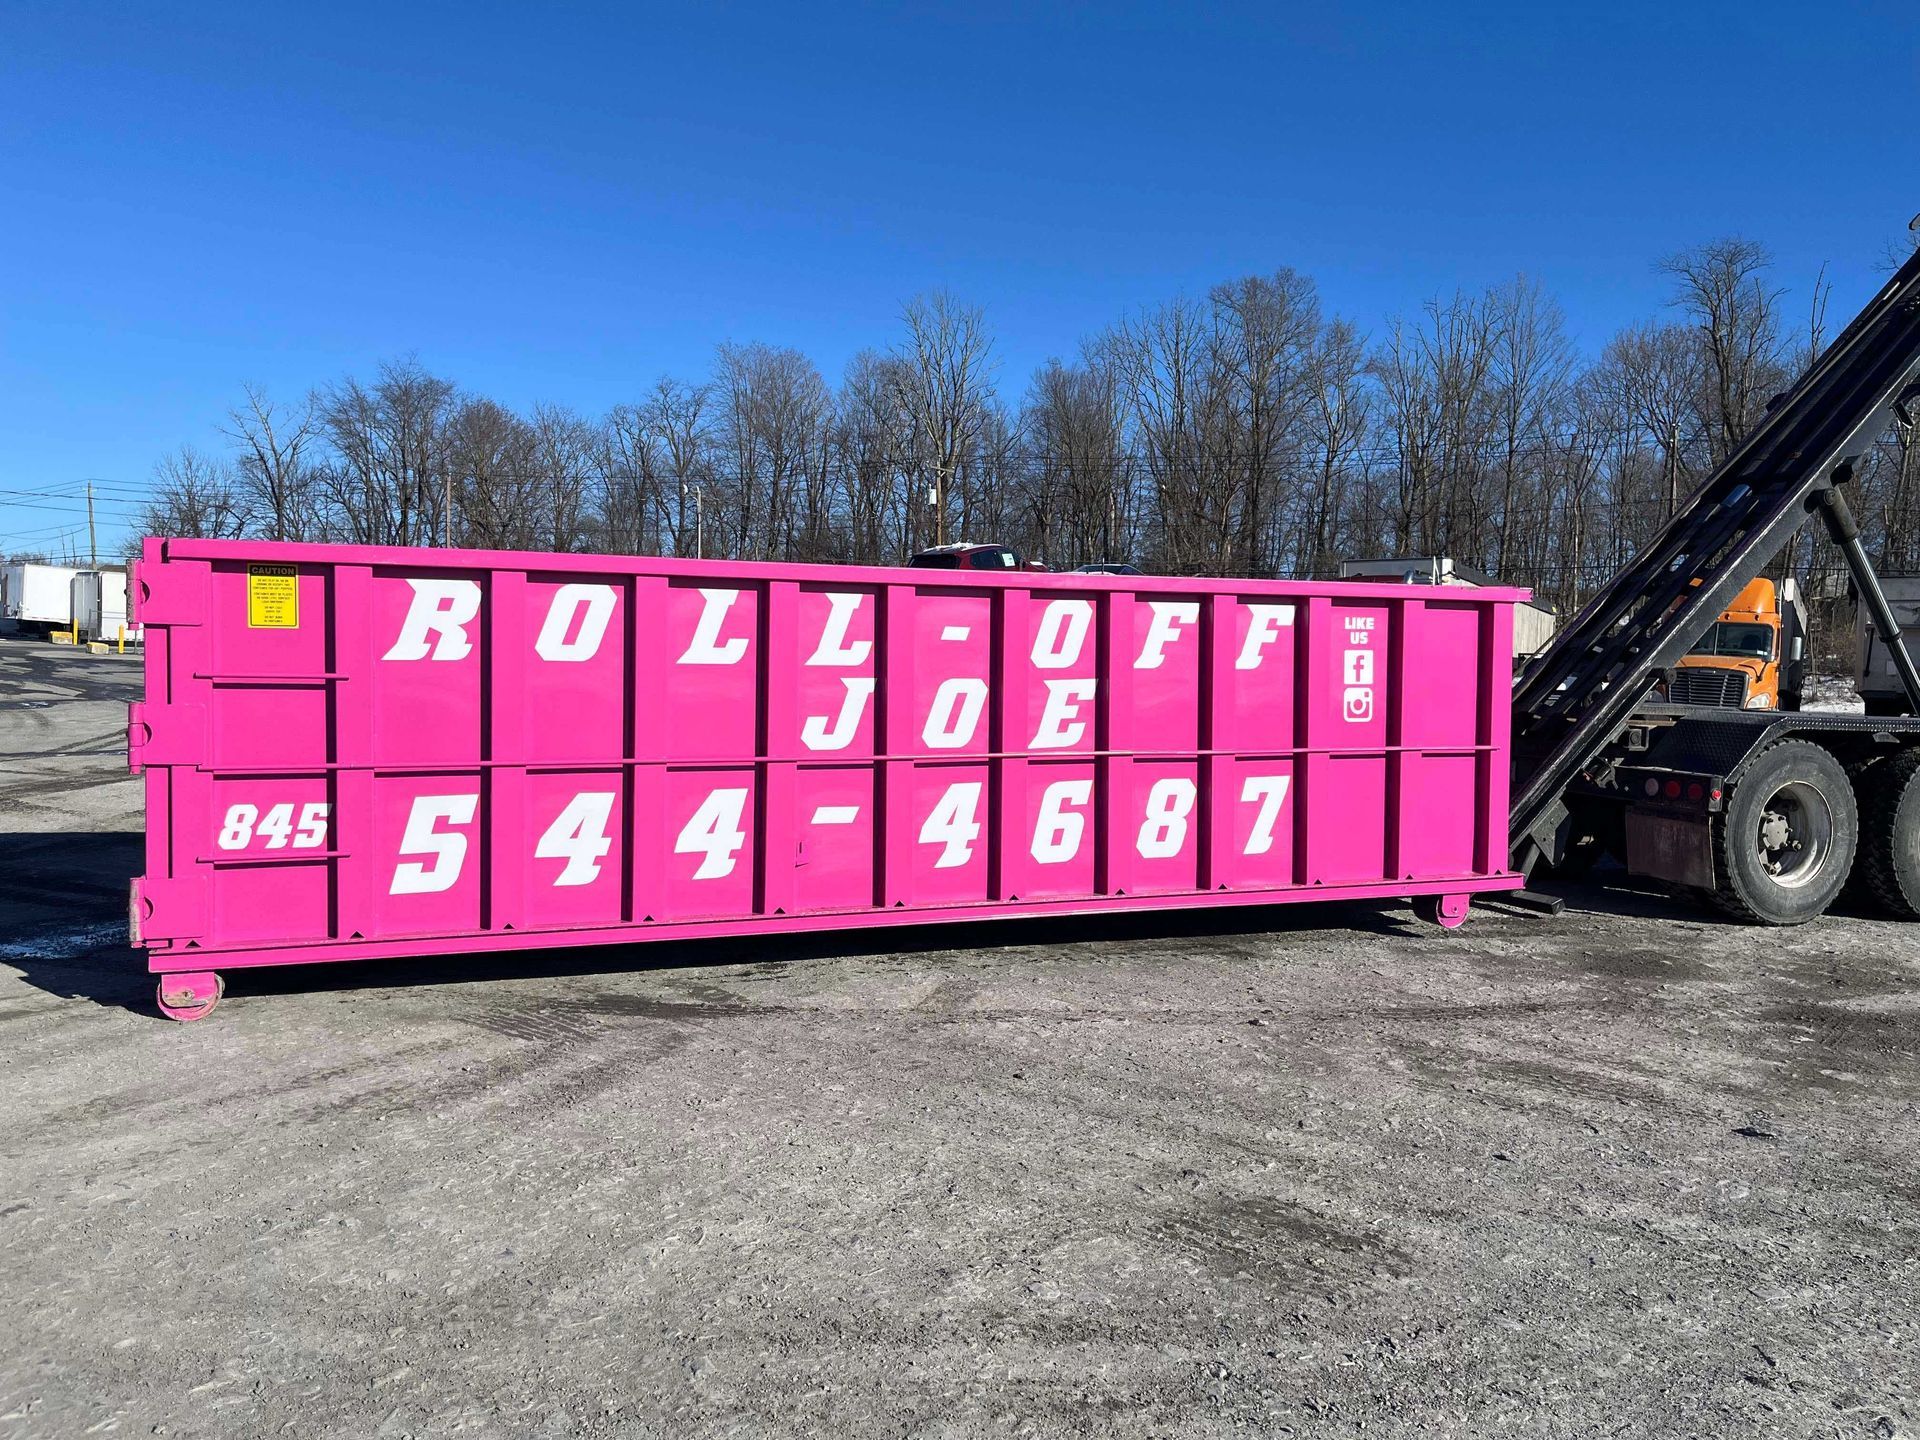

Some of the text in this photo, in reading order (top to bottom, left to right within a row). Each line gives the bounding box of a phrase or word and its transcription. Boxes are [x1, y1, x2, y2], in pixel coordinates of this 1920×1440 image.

[251, 566, 295, 576] CAUTION
[381, 578, 1296, 671] ROLL-OFF
[1344, 616, 1375, 630] LIKE
[1350, 631, 1369, 645] US
[800, 677, 1099, 751] JOE
[217, 775, 1292, 895] 845 544-4687
